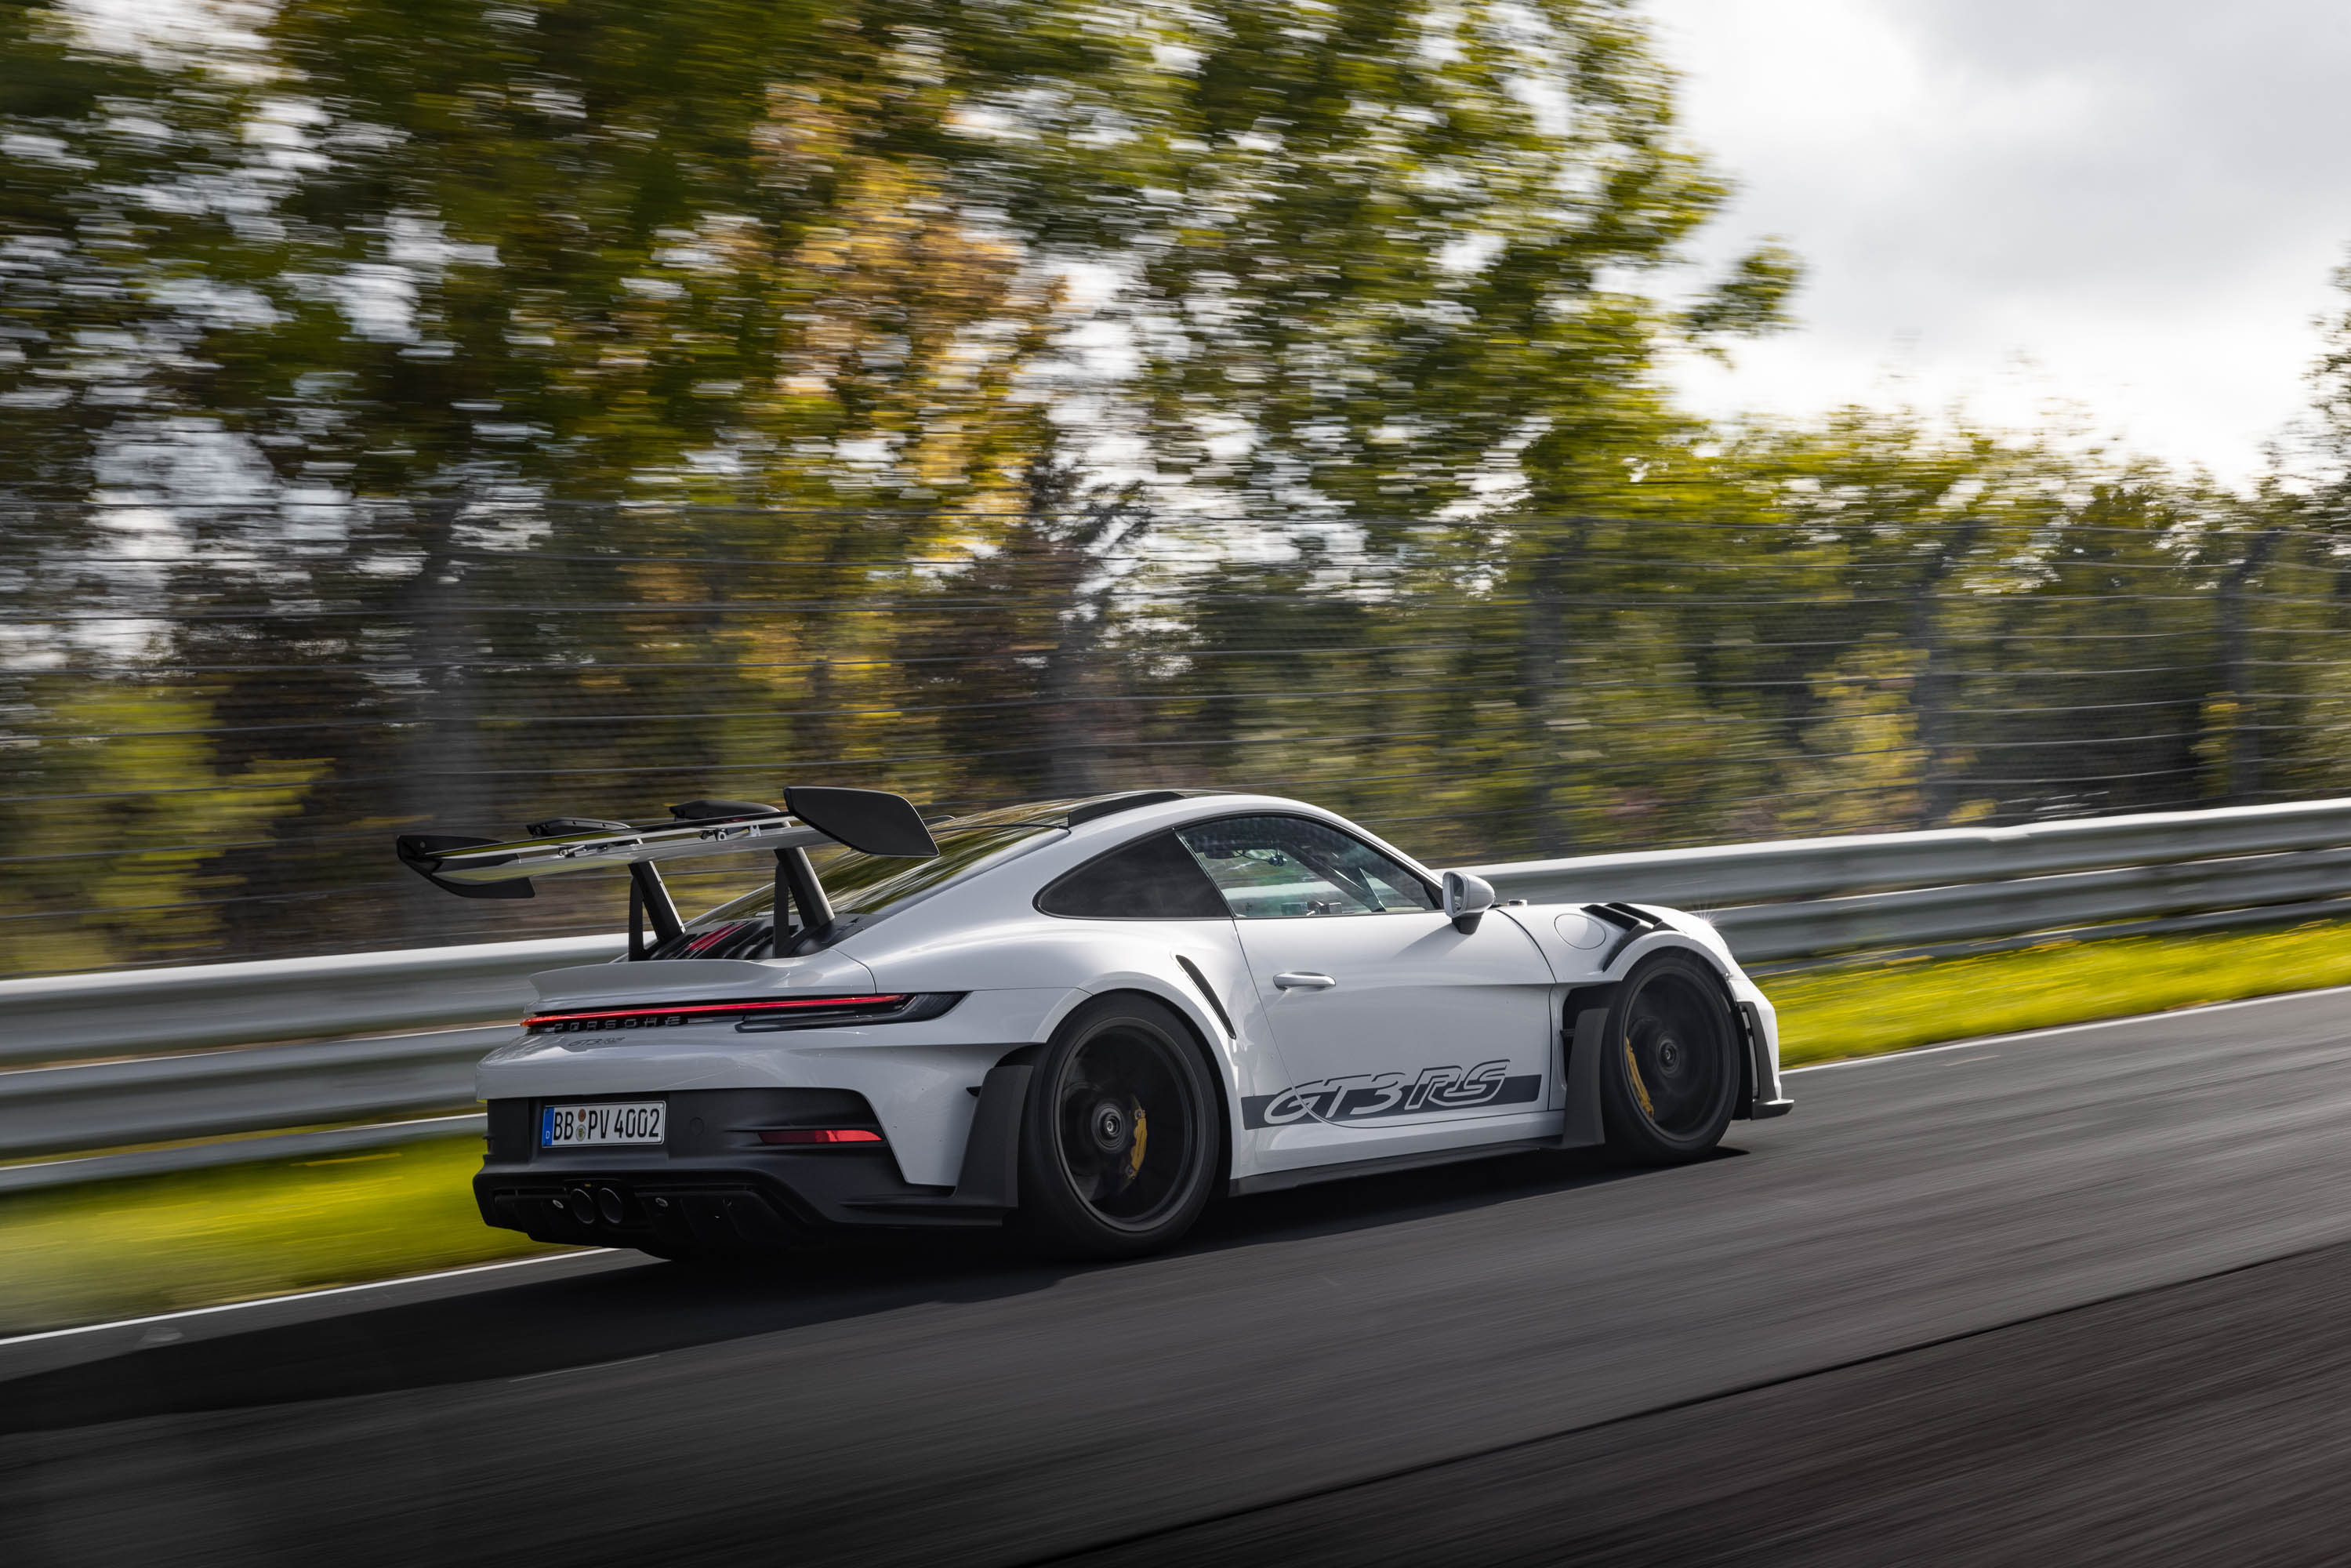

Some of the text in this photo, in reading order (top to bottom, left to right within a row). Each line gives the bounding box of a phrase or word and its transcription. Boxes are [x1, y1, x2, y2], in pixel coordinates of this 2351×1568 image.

[553, 1016, 680, 1033] PORSCHE
[553, 1108, 660, 1140] BB PV 4002
